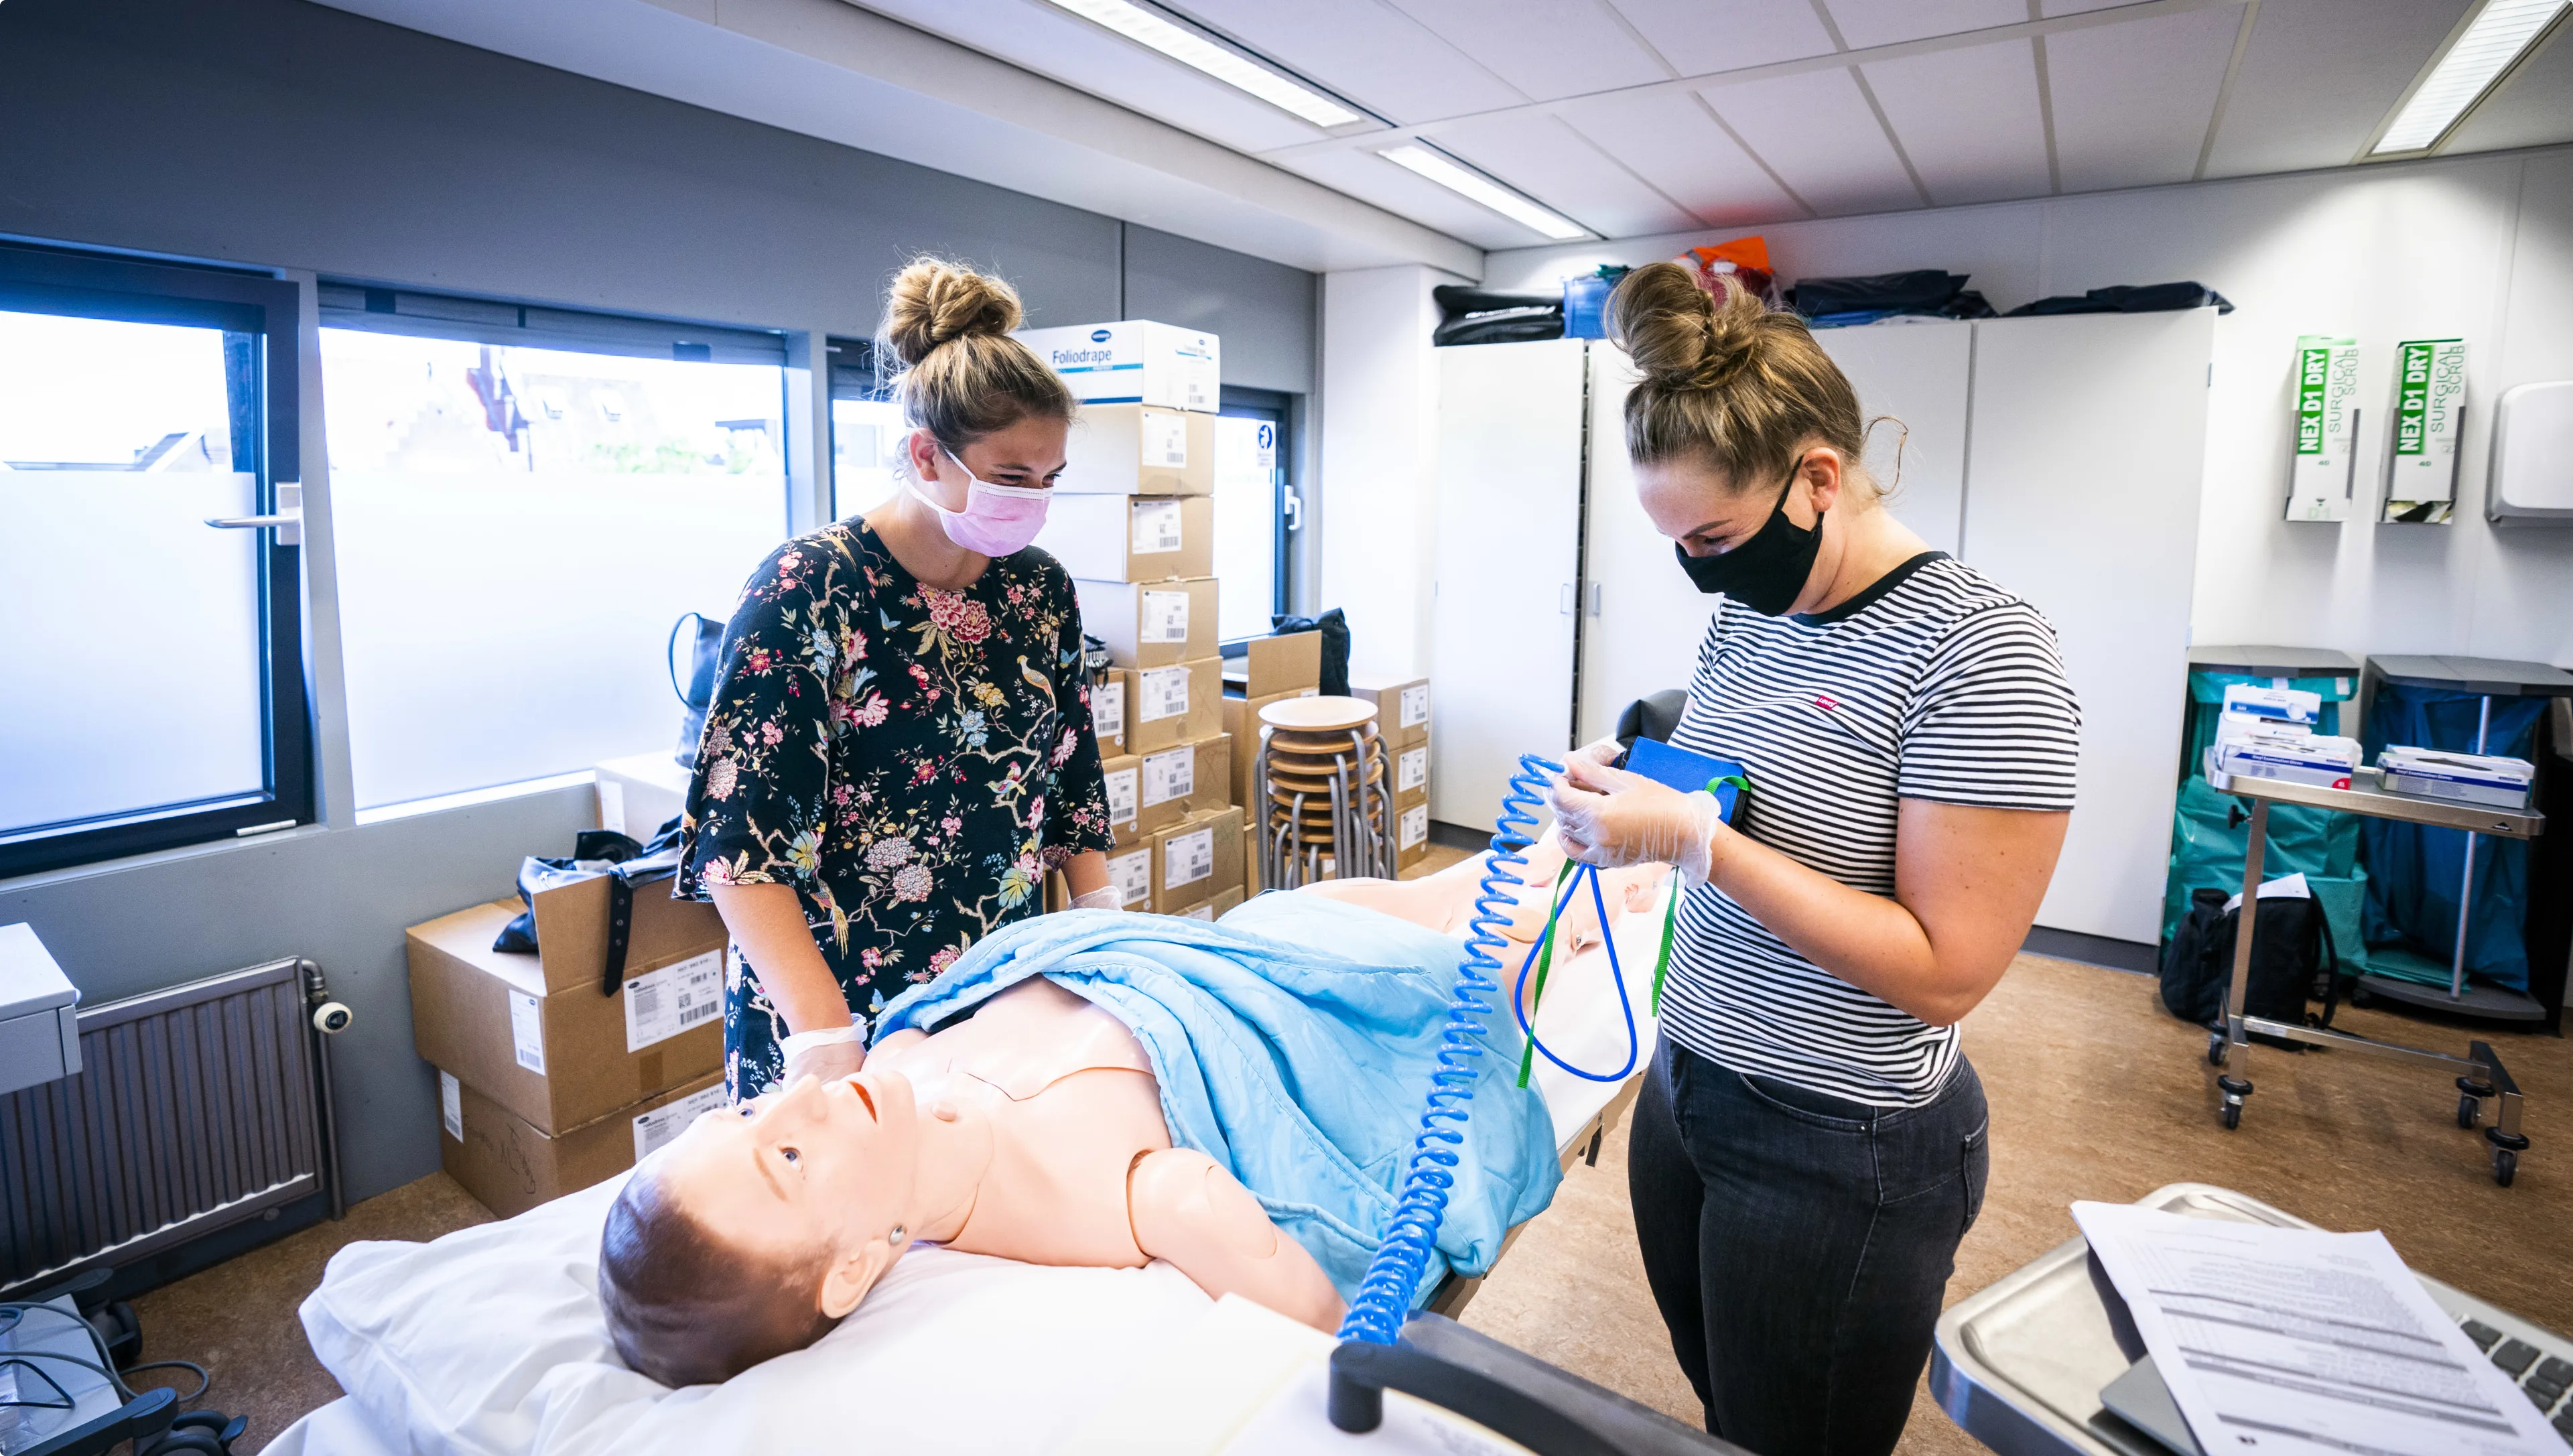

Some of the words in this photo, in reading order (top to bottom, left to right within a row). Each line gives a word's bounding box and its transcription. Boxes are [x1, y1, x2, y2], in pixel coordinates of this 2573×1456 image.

[1053, 348, 1112, 365] Foliodrape
[2305, 350, 2326, 385] DRY
[2344, 348, 2359, 396] SCRUB
[2405, 347, 2429, 383] DRY
[2448, 345, 2466, 394] SCRUB
[2302, 391, 2323, 411] D1
[2328, 350, 2347, 433] SURGICAL
[2403, 389, 2425, 411] D1
[2431, 346, 2452, 433] SURGICAL
[2300, 415, 2320, 451] NEX
[2399, 415, 2423, 451] NEX
